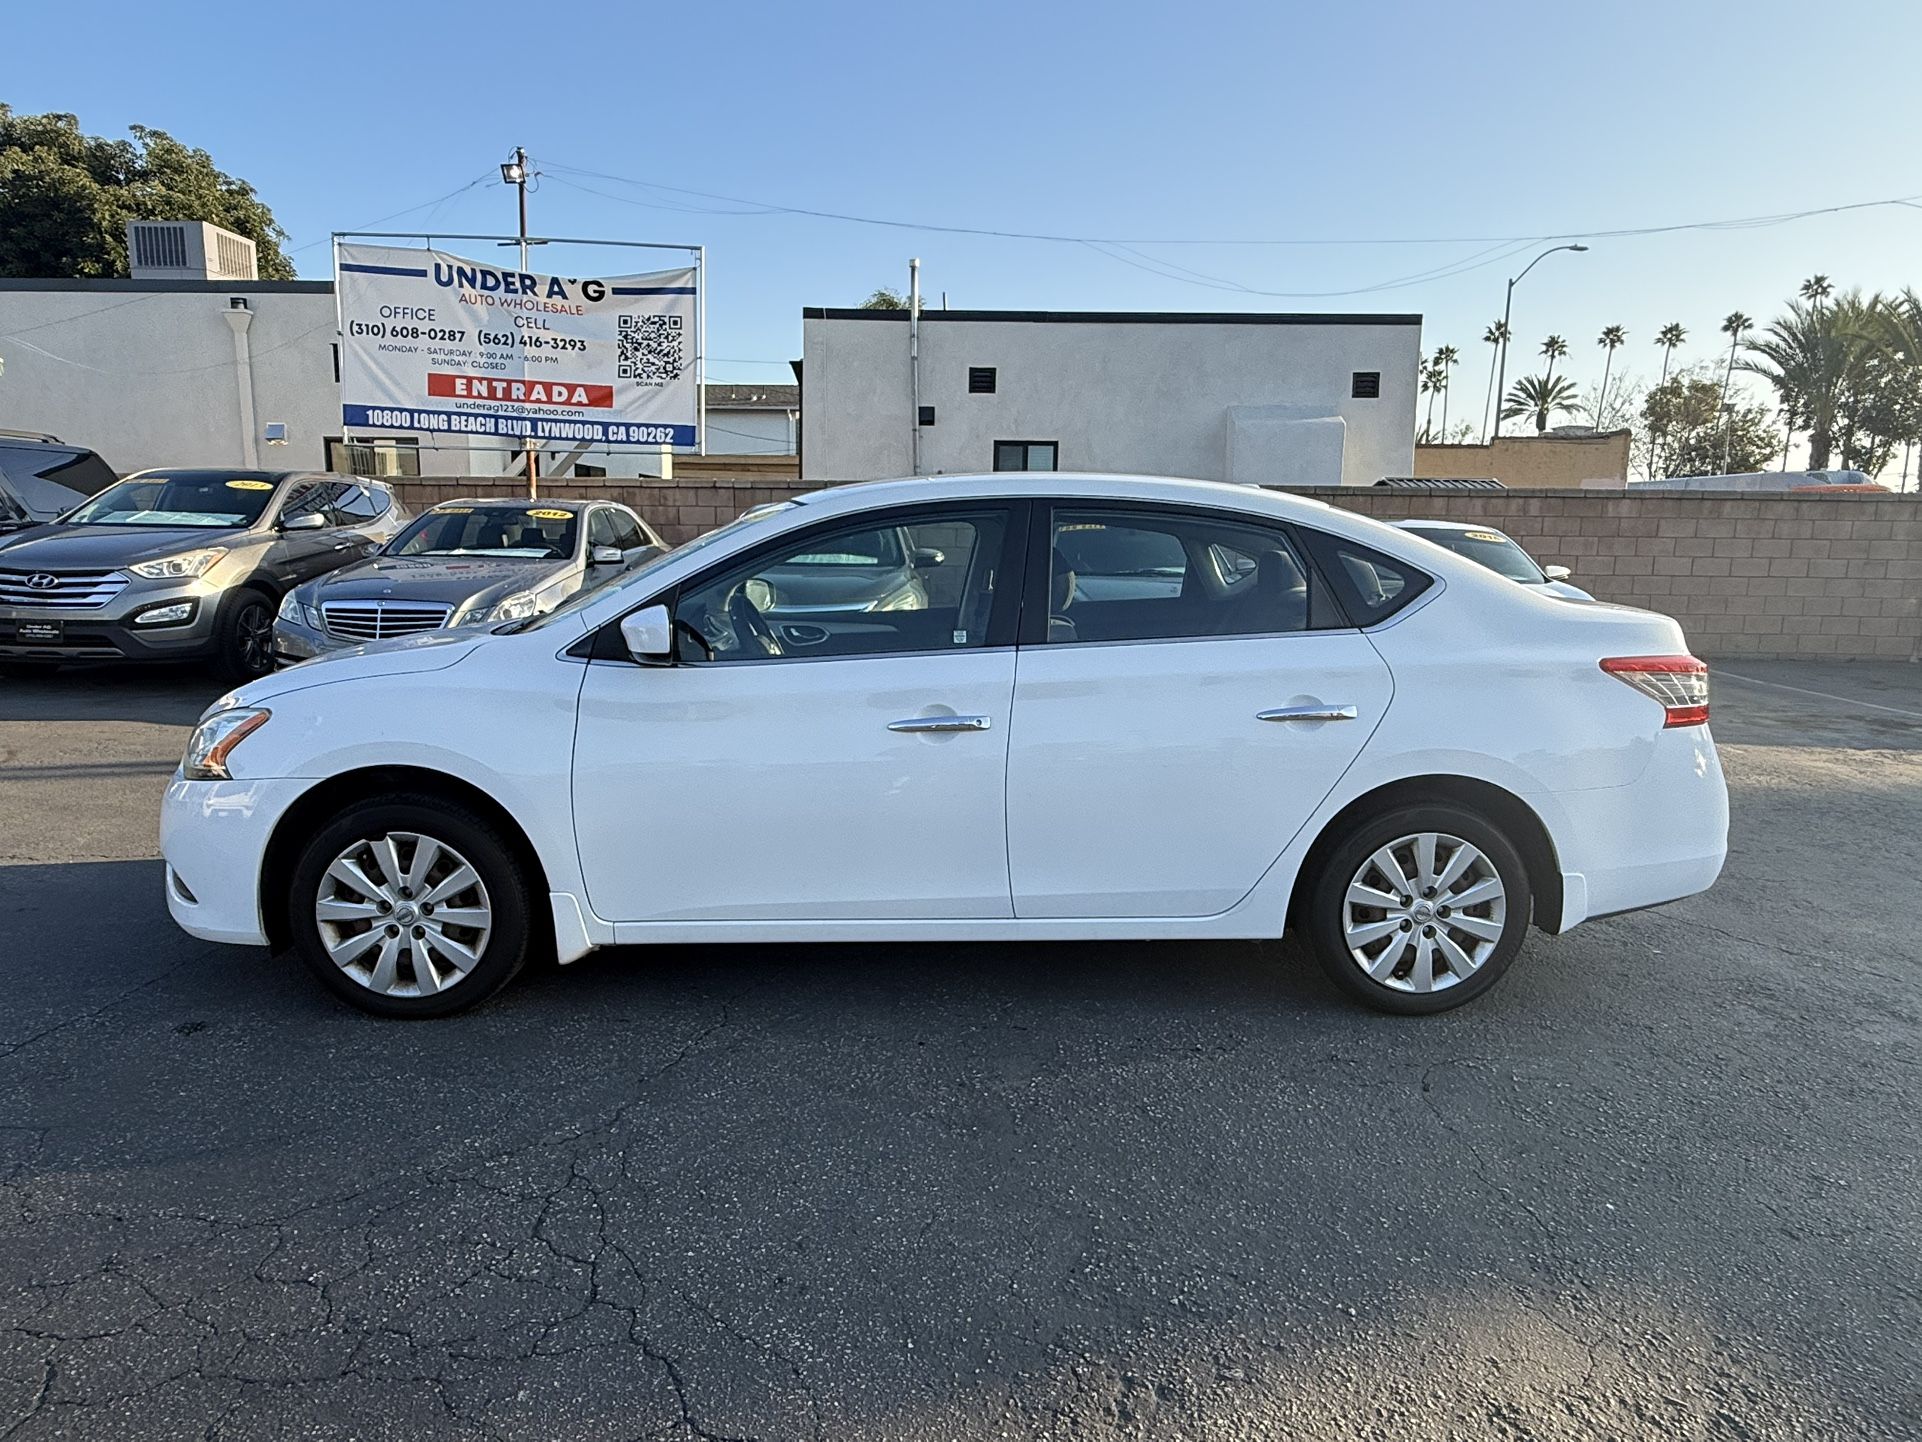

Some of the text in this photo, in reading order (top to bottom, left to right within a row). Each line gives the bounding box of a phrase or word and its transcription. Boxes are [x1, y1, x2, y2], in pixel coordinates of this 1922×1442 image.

[434, 262, 538, 298] UNDER
[379, 305, 436, 321] OFFICE
[458, 293, 584, 316] AUTO WHOLESALE
[349, 320, 466, 343] (310) 608-0287
[514, 315, 551, 331] CELL
[477, 330, 587, 352] (562) 416-3293
[378, 344, 419, 354] MONDAY
[427, 347, 473, 358] SATURDAY
[478, 351, 498, 361] 9:00
[499, 353, 514, 361] AM
[523, 355, 543, 363] 6:00
[545, 356, 559, 364] PM
[470, 360, 507, 370] CLOSED
[455, 378, 589, 405] ENTRADA
[455, 401, 585, 418] underag123@yahoo.com
[366, 409, 674, 443] 10800 LONG BEACH BLVD. LYNWOOD, CA 90262
